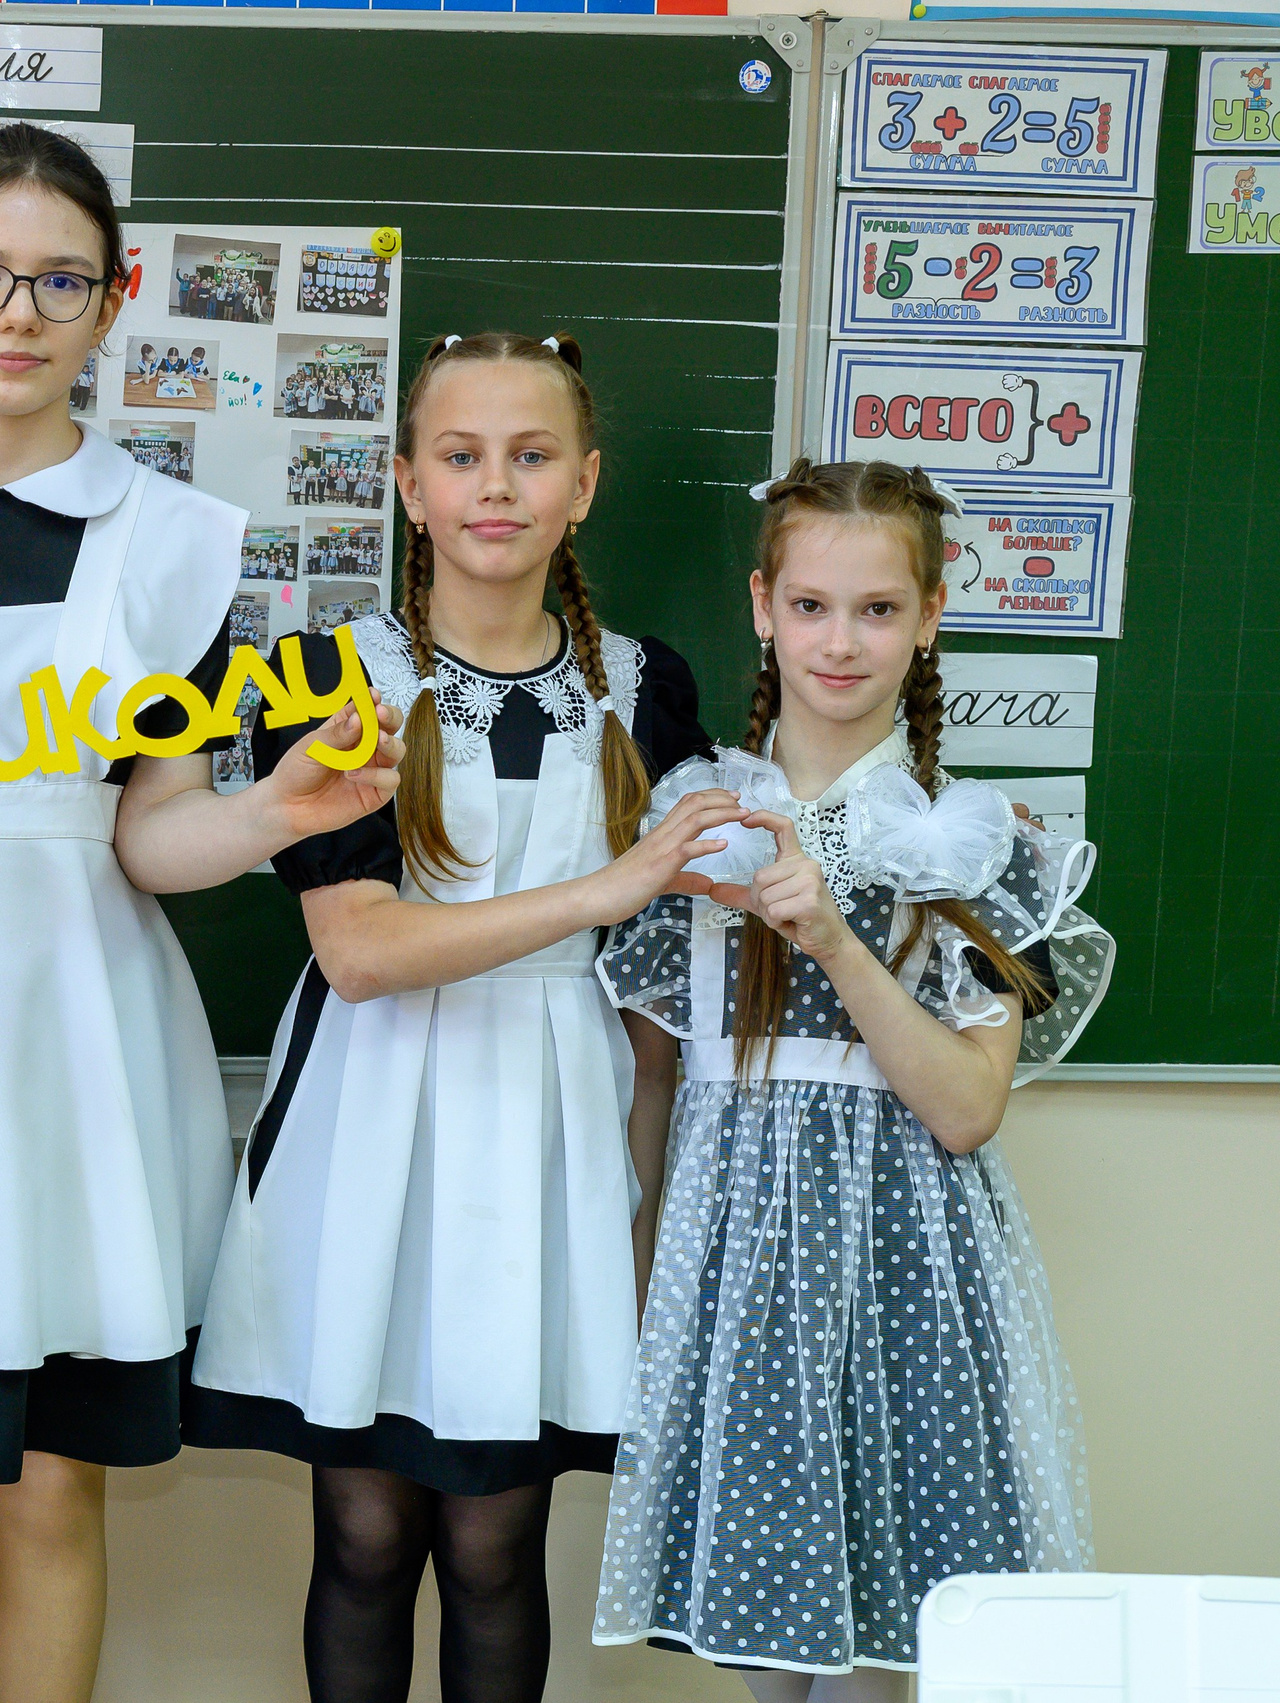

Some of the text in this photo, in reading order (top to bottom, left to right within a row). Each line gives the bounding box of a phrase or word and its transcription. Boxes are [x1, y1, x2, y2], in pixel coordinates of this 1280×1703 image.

[872, 72, 1059, 92] СЛАГАЕМОЕ СЛАГАЕМОЕ
[910, 154, 1108, 174] СУММА СУММА
[862, 219, 1073, 237] УМЕНЬШАЕМОЕ ВЫЧИТАЕМОЕ
[892, 303, 1108, 323] РАЗНОСТЬ РАЗНОСТЬ
[853, 394, 1015, 443] ВСЕГО
[988, 517, 1096, 534] НА СКОЛЬКО
[1003, 536, 1082, 551] БОЛЬШЕ?
[984, 577, 1091, 594] НА СКОЛЬКО
[999, 595, 1078, 611] МЕНЬШЕ?
